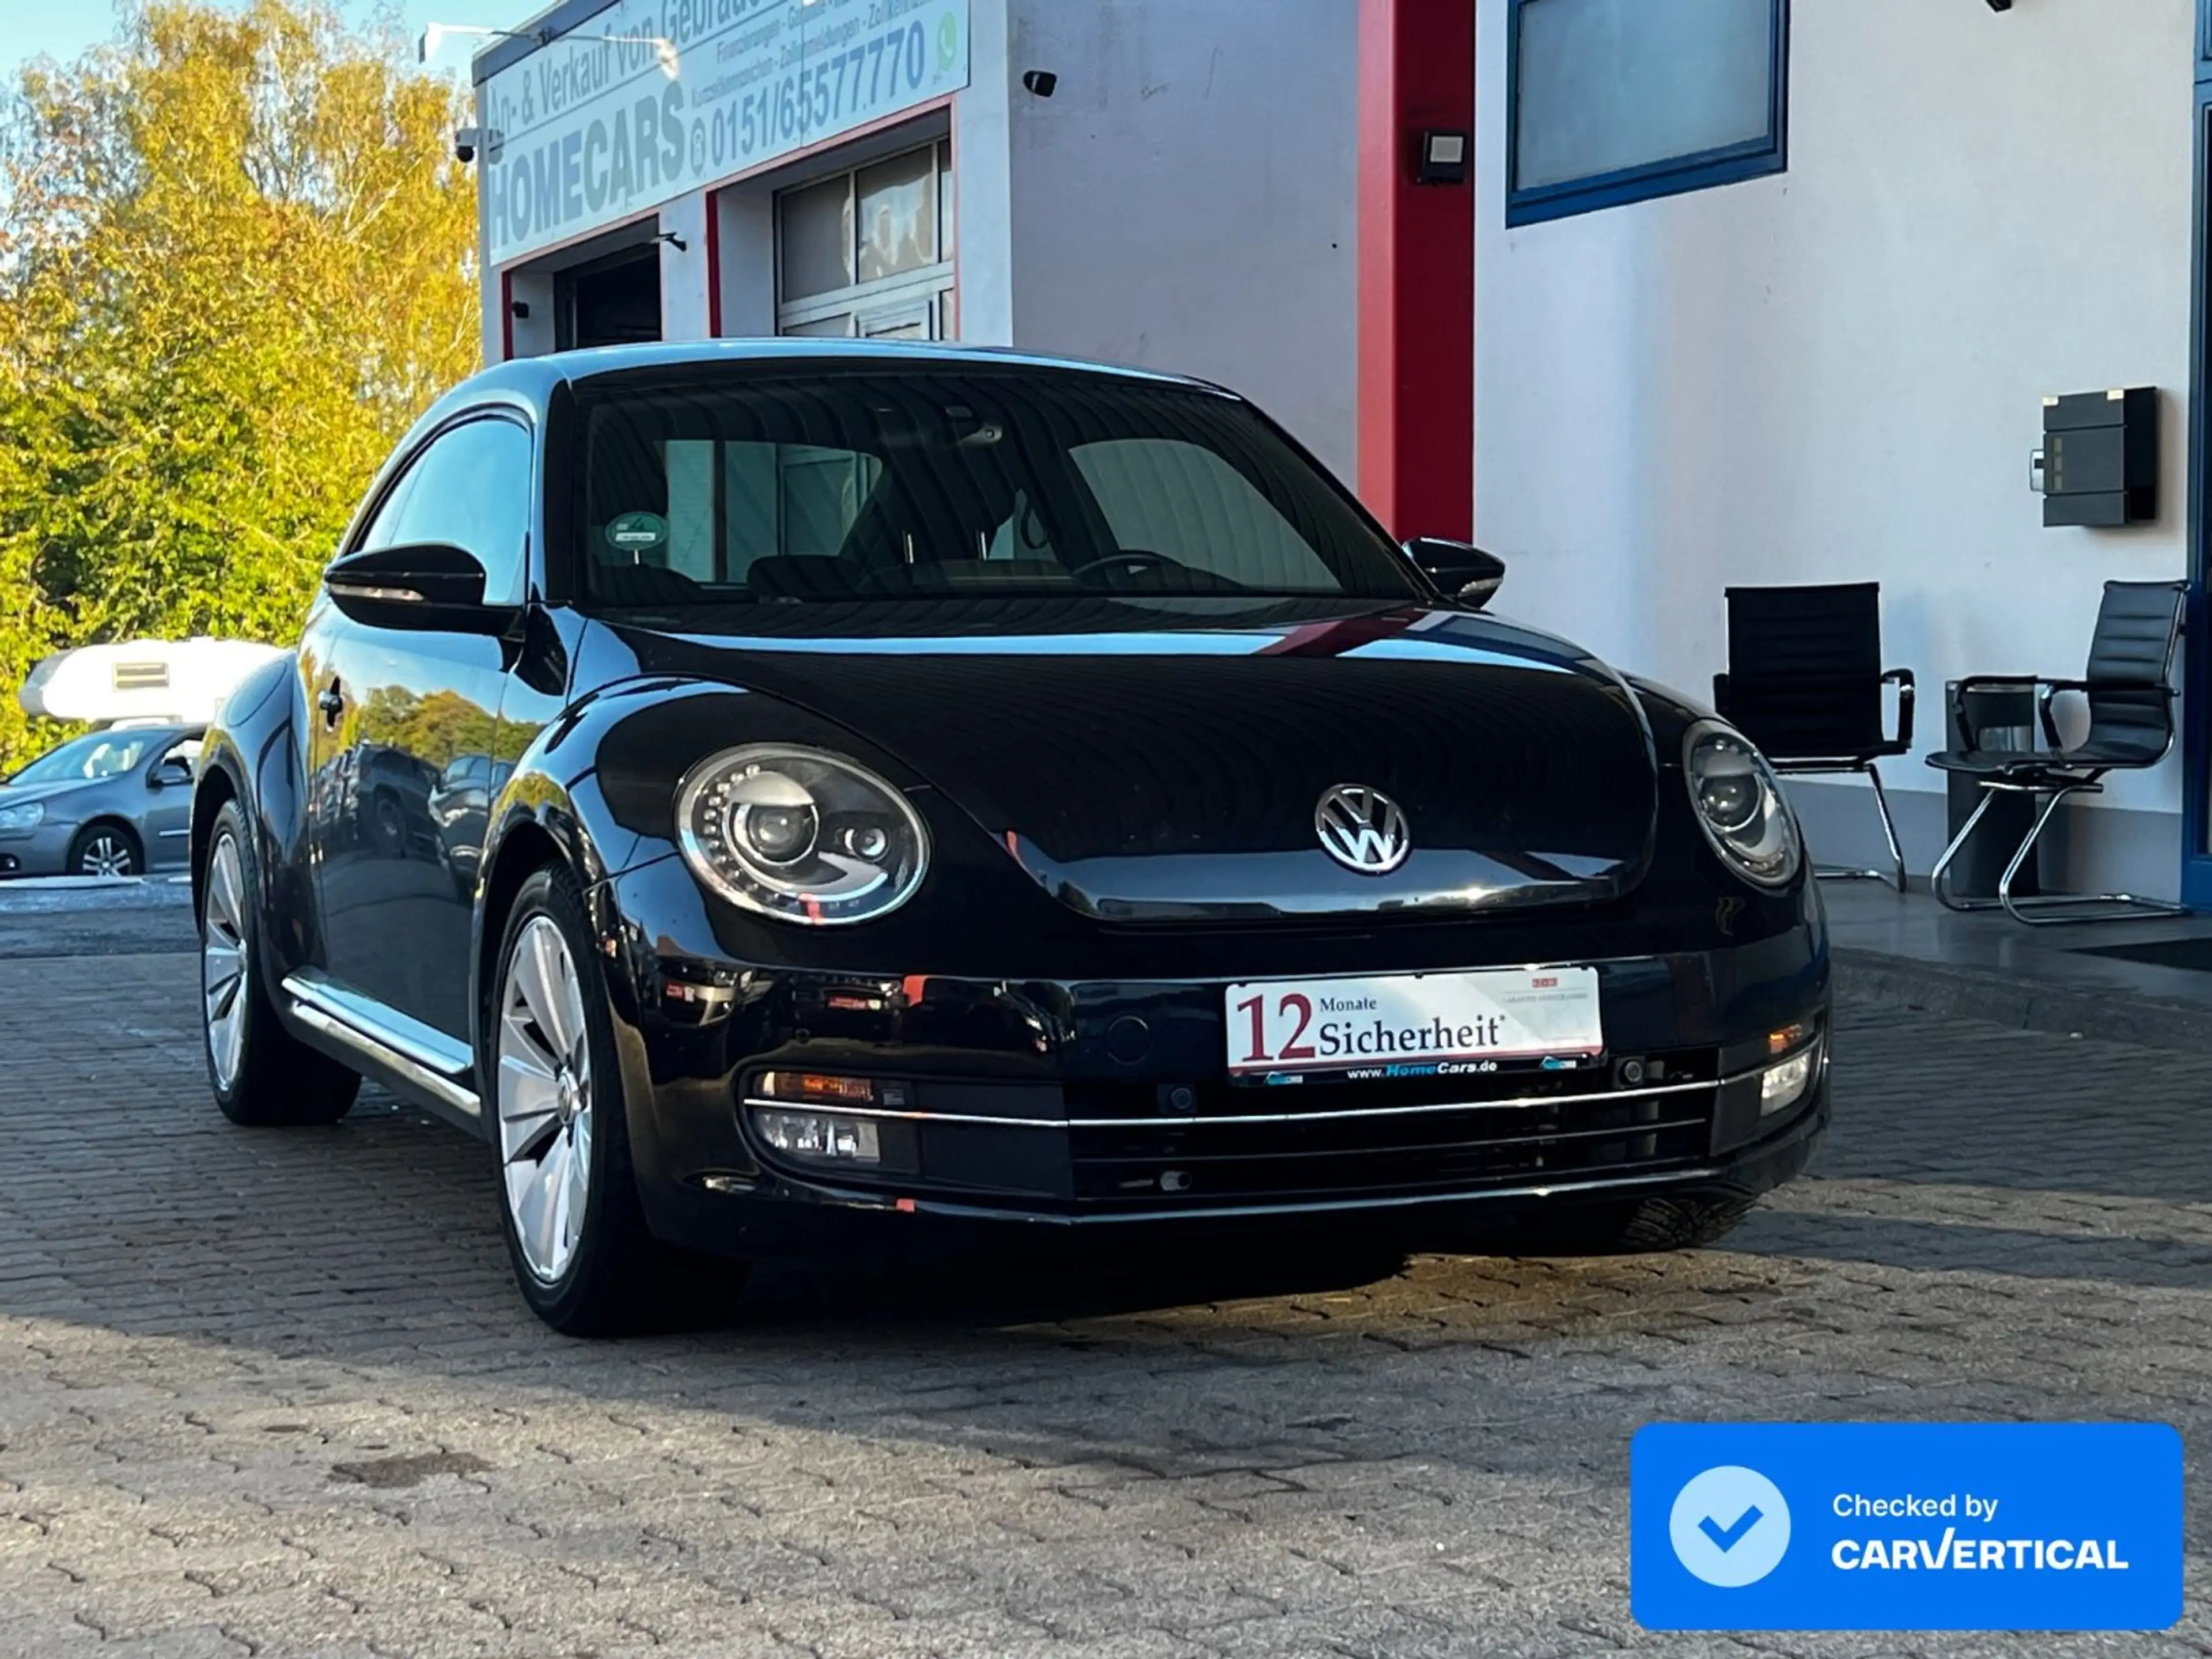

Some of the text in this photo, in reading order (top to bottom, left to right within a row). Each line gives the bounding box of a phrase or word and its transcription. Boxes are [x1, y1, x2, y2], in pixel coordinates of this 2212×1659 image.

[539, 22, 612, 115] Verkauf
[616, 16, 654, 77] von
[490, 80, 685, 250] HOMECARS
[1237, 993, 1316, 1062] 12
[1320, 997, 1377, 1013] Monate
[1347, 1059, 1498, 1080] www.HomeCars.de
